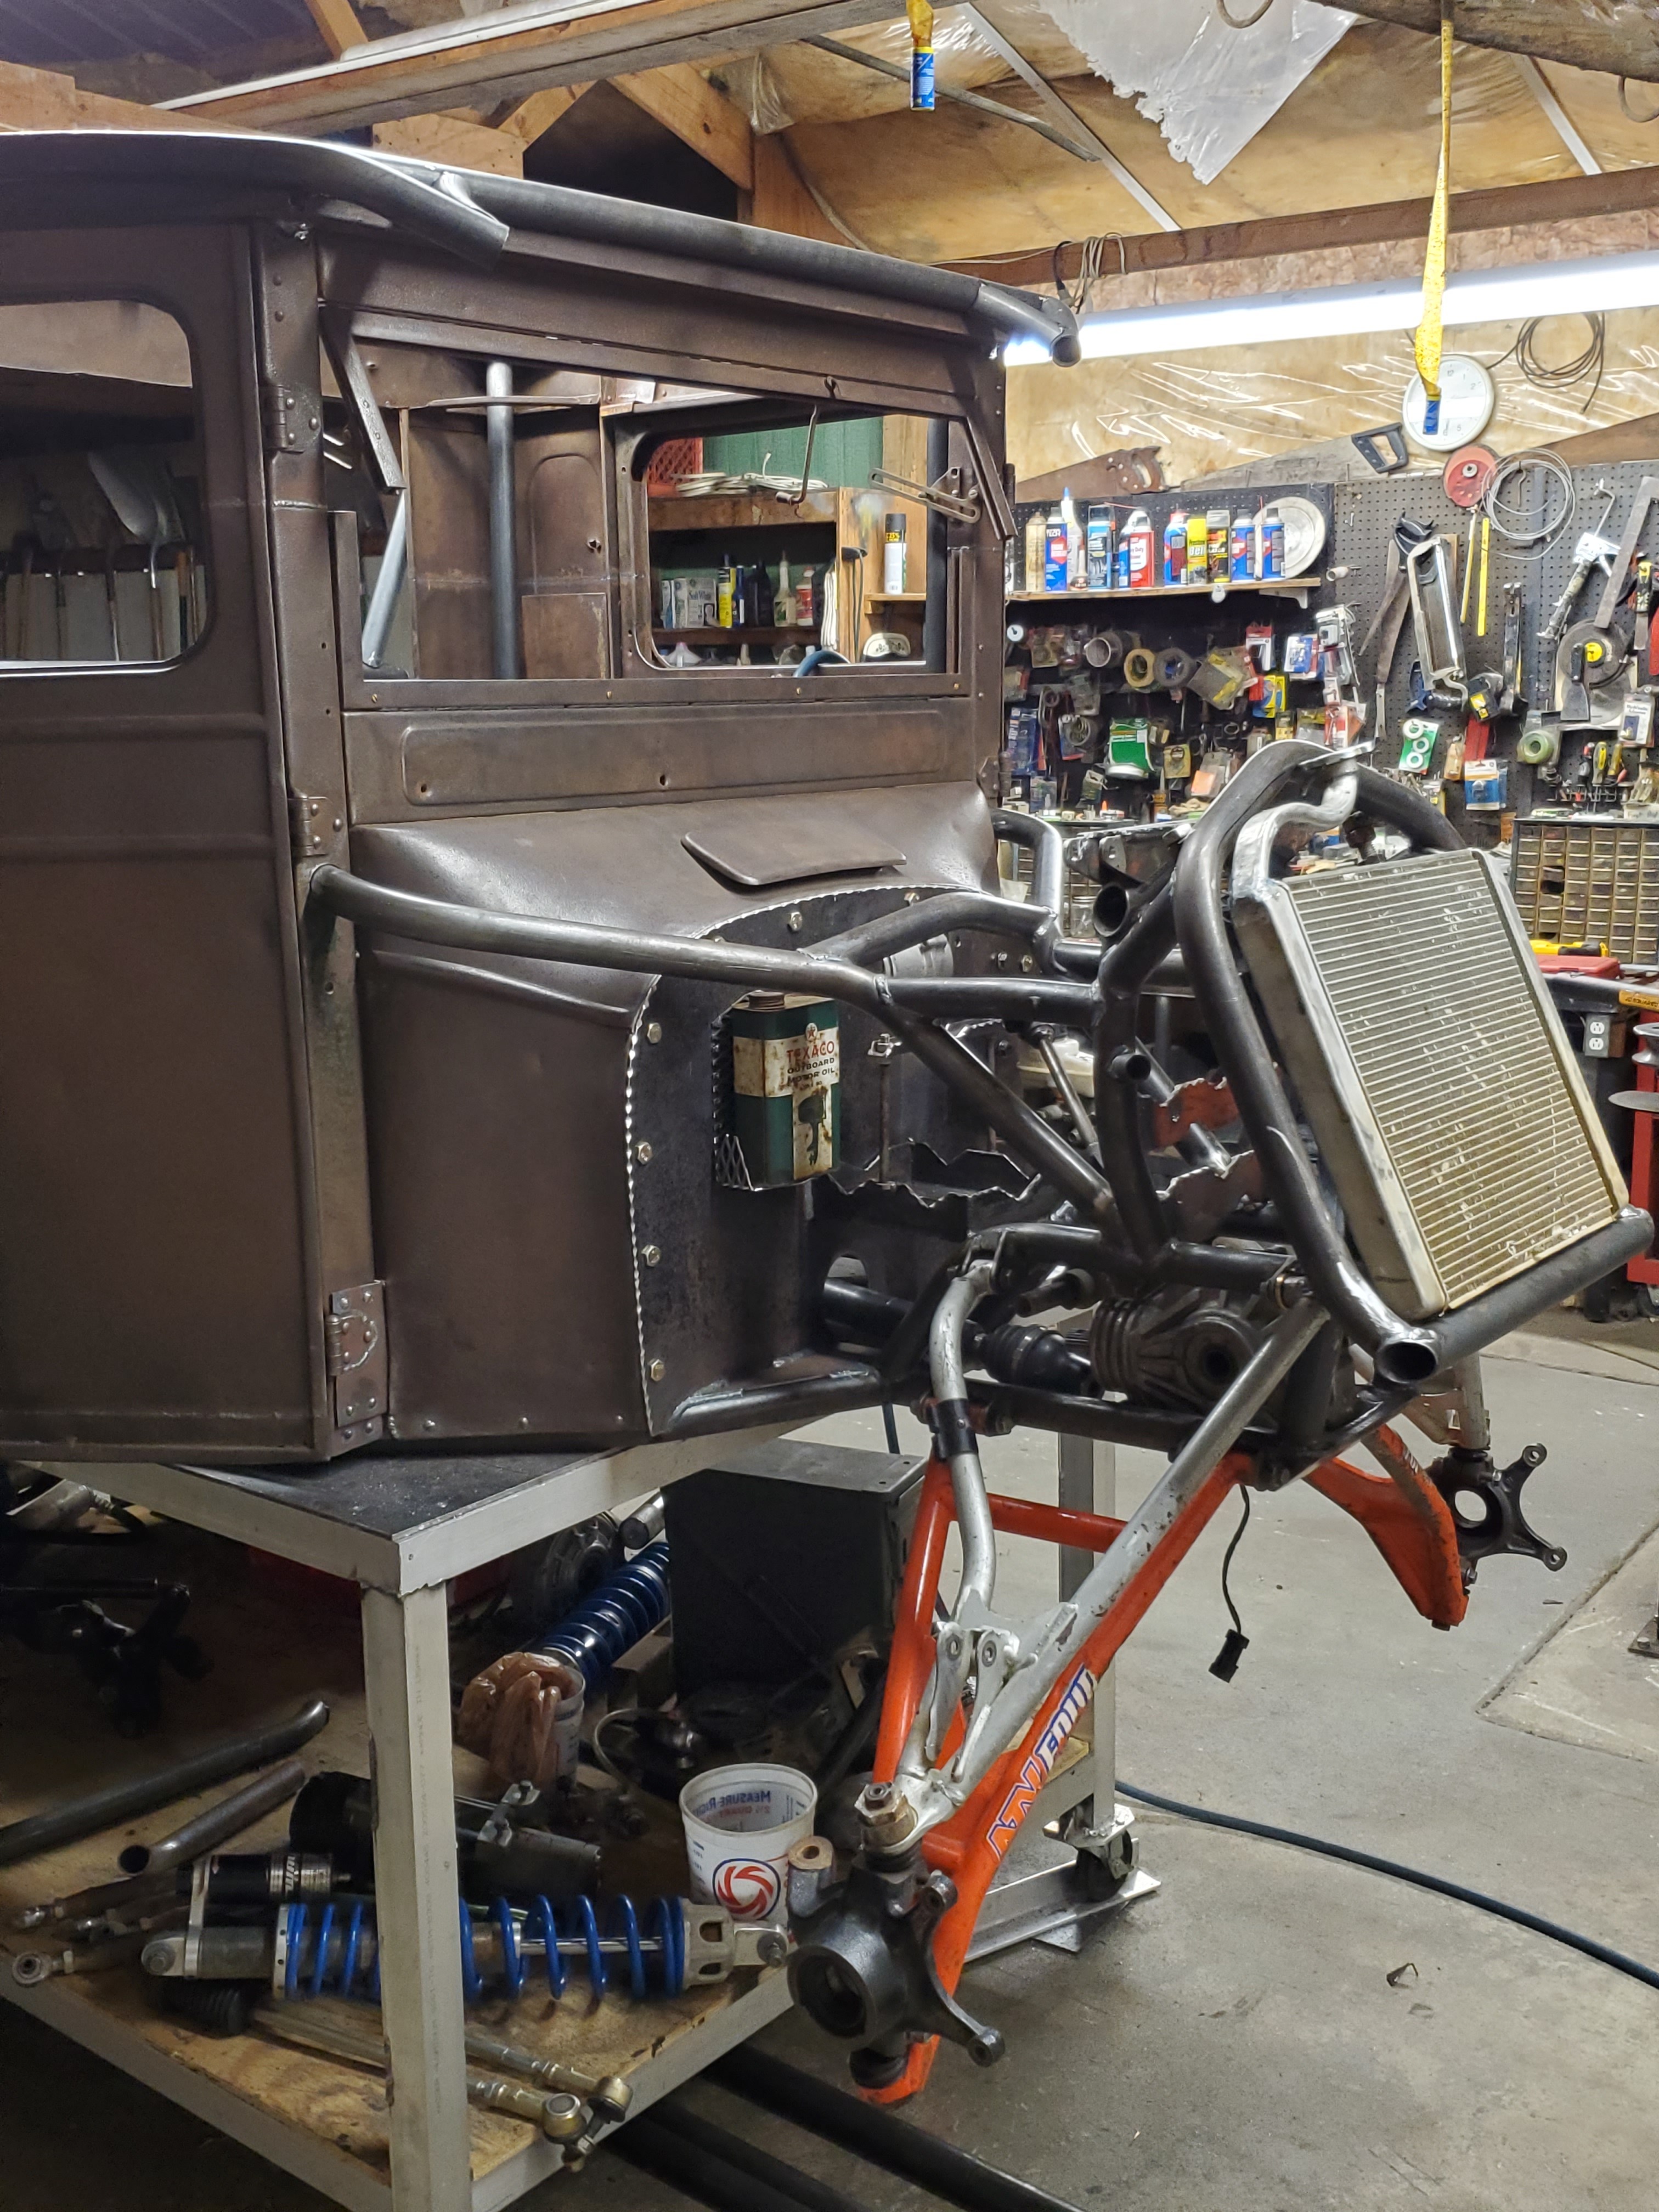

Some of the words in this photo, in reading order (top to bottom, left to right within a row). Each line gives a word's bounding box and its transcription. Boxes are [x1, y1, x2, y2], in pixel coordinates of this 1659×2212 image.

[786, 1041, 835, 1064] TEXACO
[787, 1058, 835, 1074] OUTBOARD
[787, 1071, 821, 1087] MOTOR
